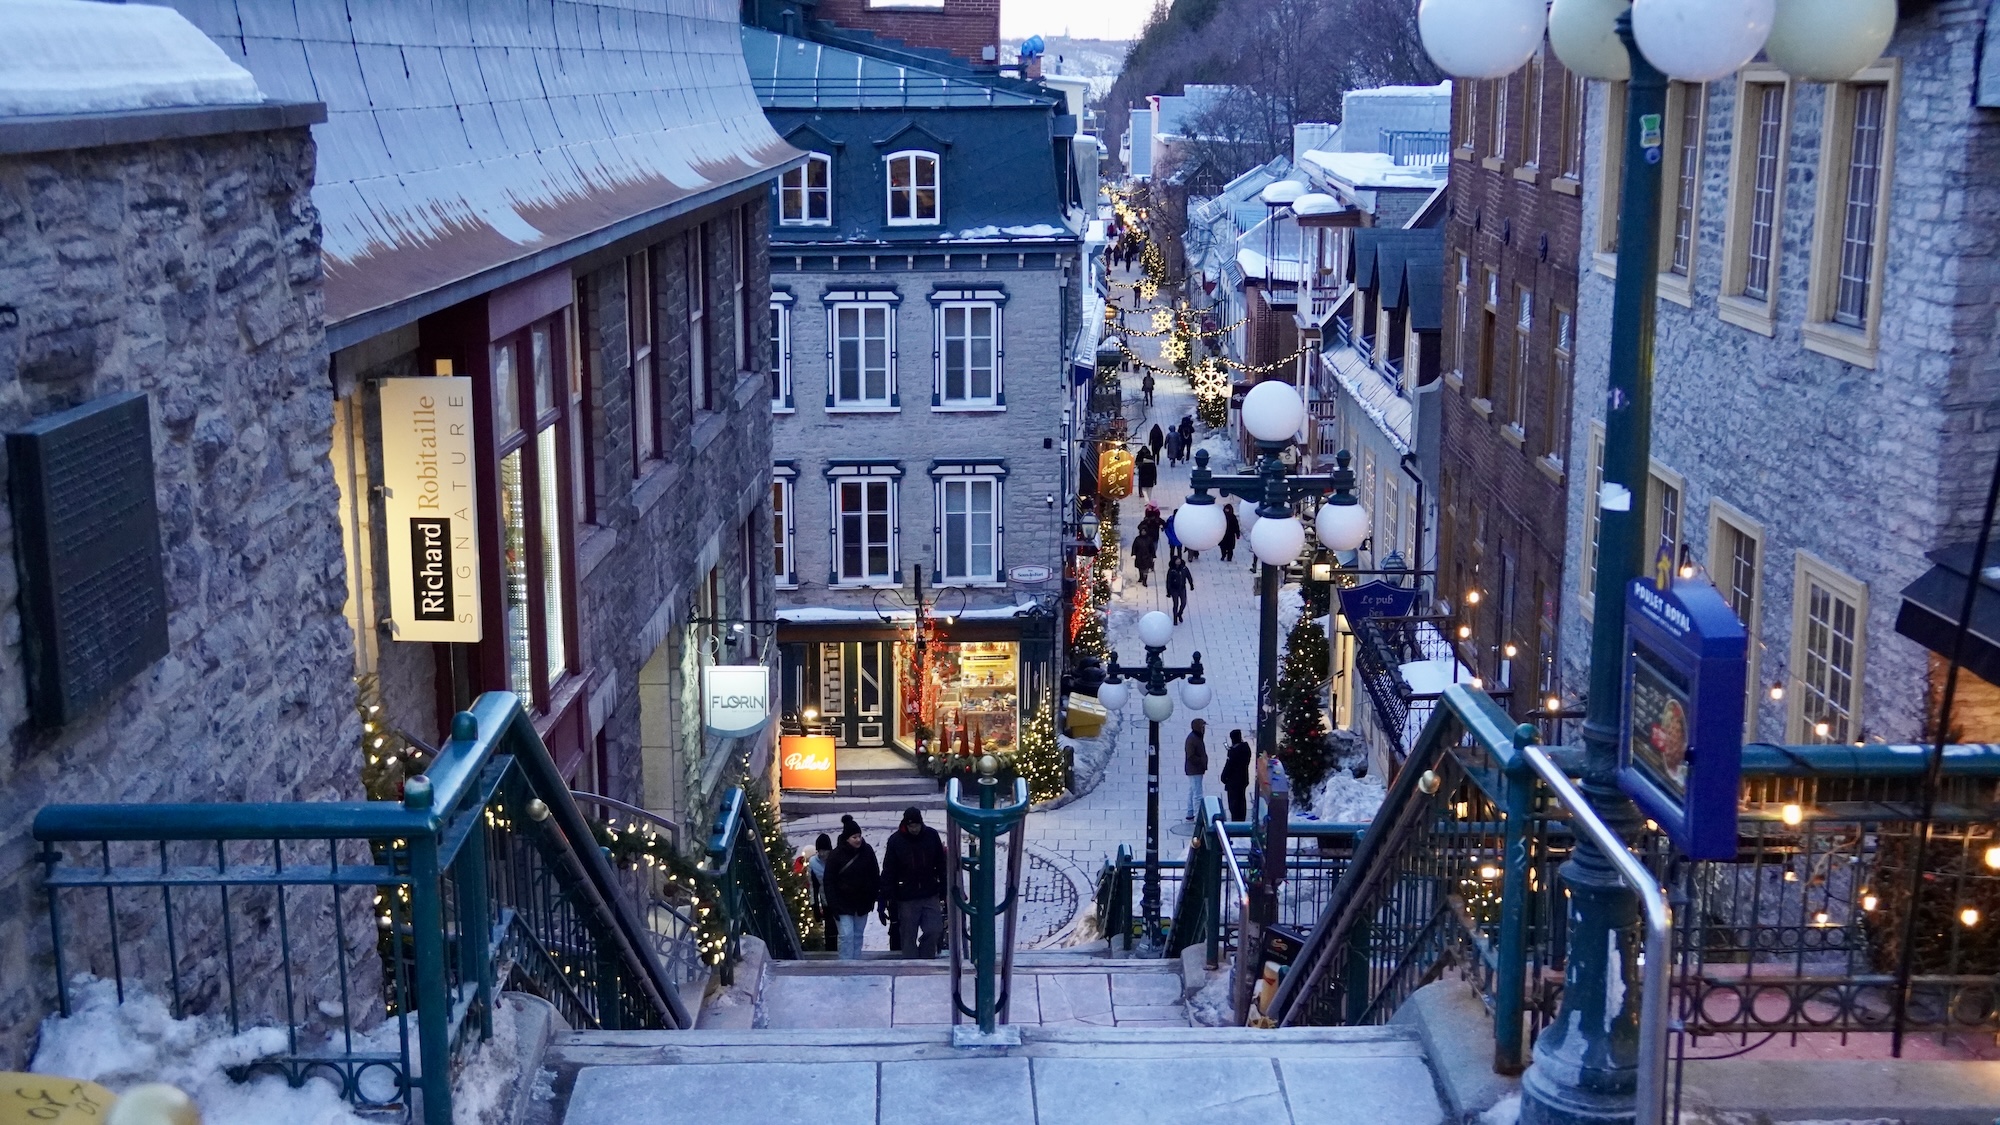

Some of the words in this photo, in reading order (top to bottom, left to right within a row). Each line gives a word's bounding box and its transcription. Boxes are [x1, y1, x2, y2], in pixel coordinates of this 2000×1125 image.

[413, 395, 440, 511] Robitaille
[448, 395, 473, 624] SIGNATURE
[418, 523, 445, 615] Richard
[1360, 595, 1373, 604] Le
[1375, 594, 1394, 605] pub
[1634, 582, 1664, 612] POULET
[1664, 603, 1691, 632] ROYAL
[712, 695, 764, 709] FLORIN
